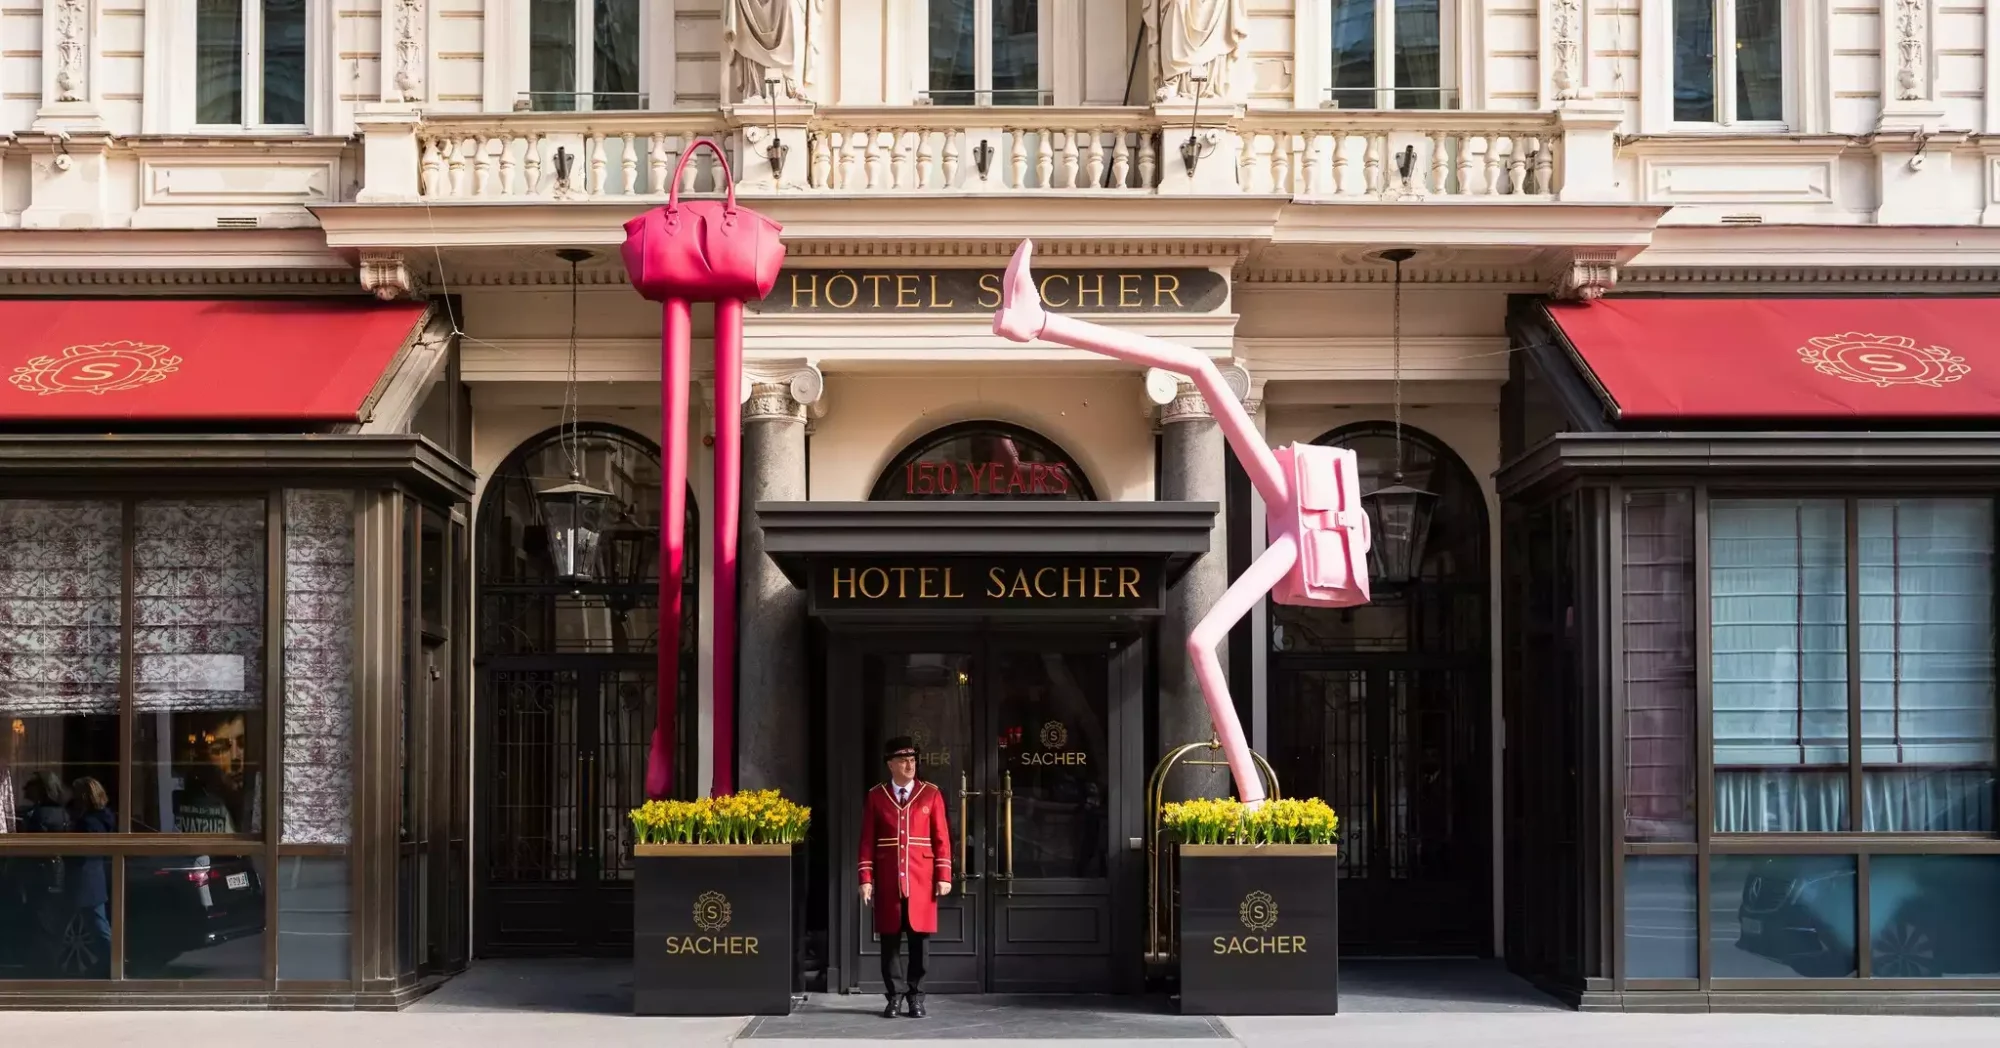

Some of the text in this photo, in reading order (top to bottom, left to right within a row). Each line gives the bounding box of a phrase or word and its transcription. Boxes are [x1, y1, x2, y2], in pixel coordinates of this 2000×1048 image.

[791, 270, 1184, 308] HÔTEL SCHER
[72, 363, 120, 380] S
[1859, 354, 1906, 372] S
[906, 461, 1070, 494] 150 YEARS
[833, 567, 1141, 598] HOTEL SACHER
[1021, 752, 1087, 765] SACHER
[707, 906, 717, 919] S
[1254, 906, 1264, 919] S
[666, 936, 759, 954] SACHER
[1213, 935, 1307, 954] SACHER
